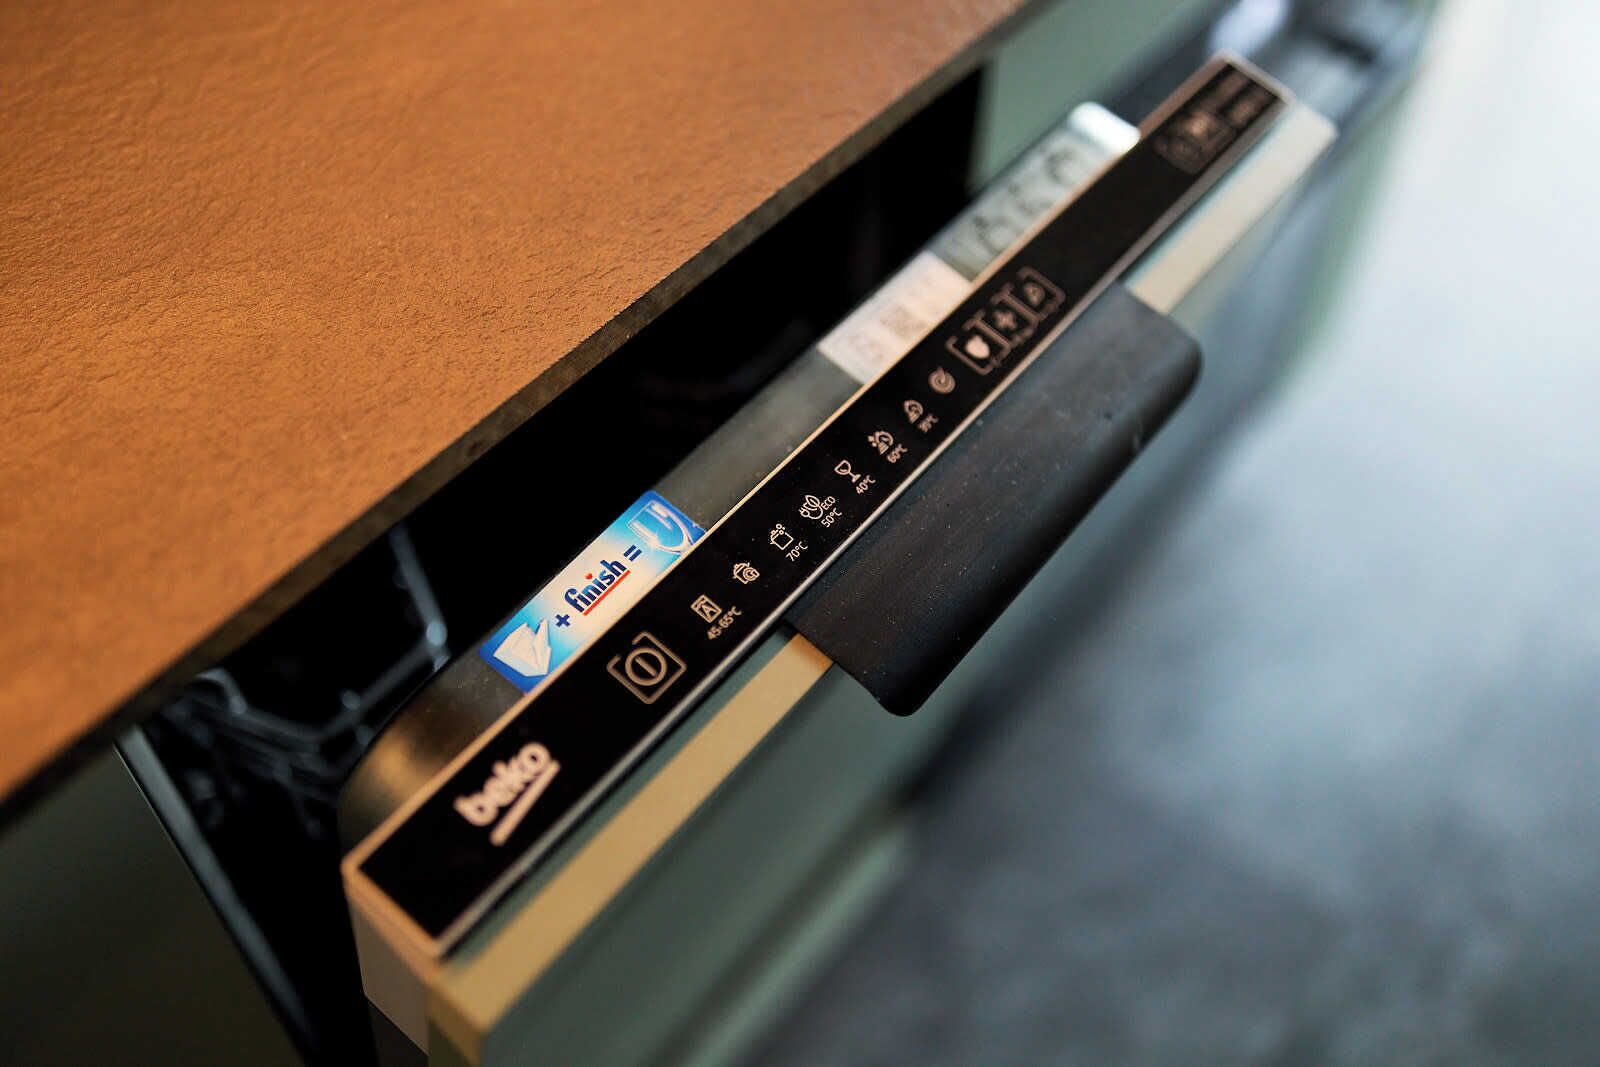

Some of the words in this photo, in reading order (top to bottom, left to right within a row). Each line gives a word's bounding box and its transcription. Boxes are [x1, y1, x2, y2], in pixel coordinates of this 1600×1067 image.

[855, 474, 876, 495] 40°C
[820, 495, 836, 511] ECO
[820, 507, 843, 528] 50°C
[785, 541, 808, 562] 70°C
[564, 559, 627, 613] finish
[452, 742, 552, 827] beko
